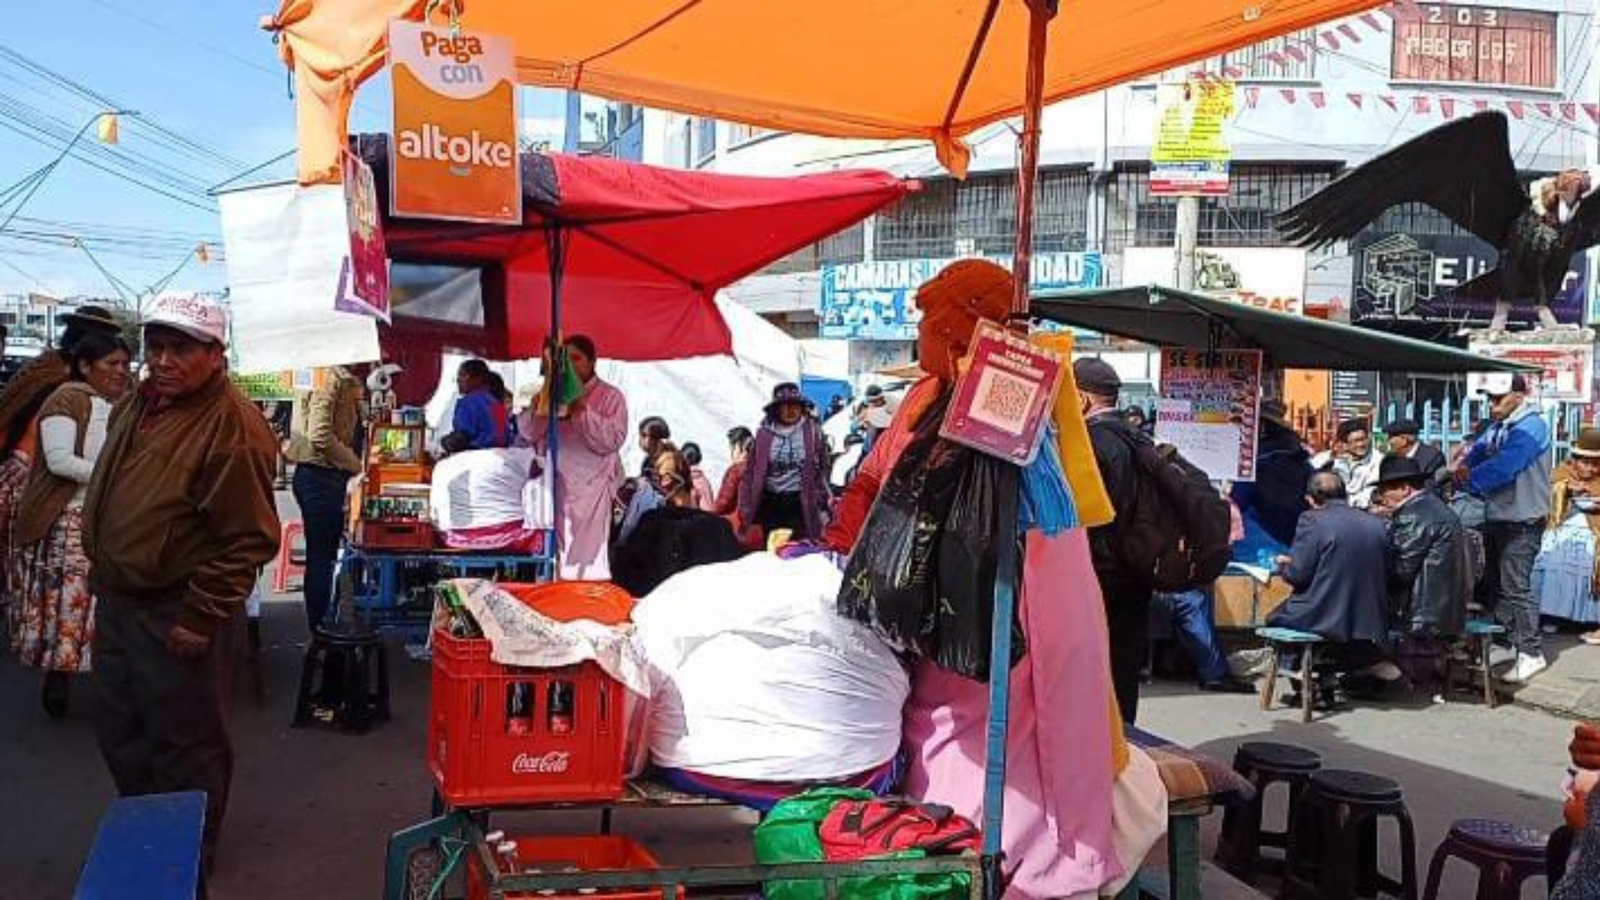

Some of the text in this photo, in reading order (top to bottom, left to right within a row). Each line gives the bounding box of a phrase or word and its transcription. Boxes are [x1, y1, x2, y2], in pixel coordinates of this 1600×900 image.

[421, 31, 484, 63] Paga
[440, 64, 483, 84] con
[399, 123, 512, 168] altoke
